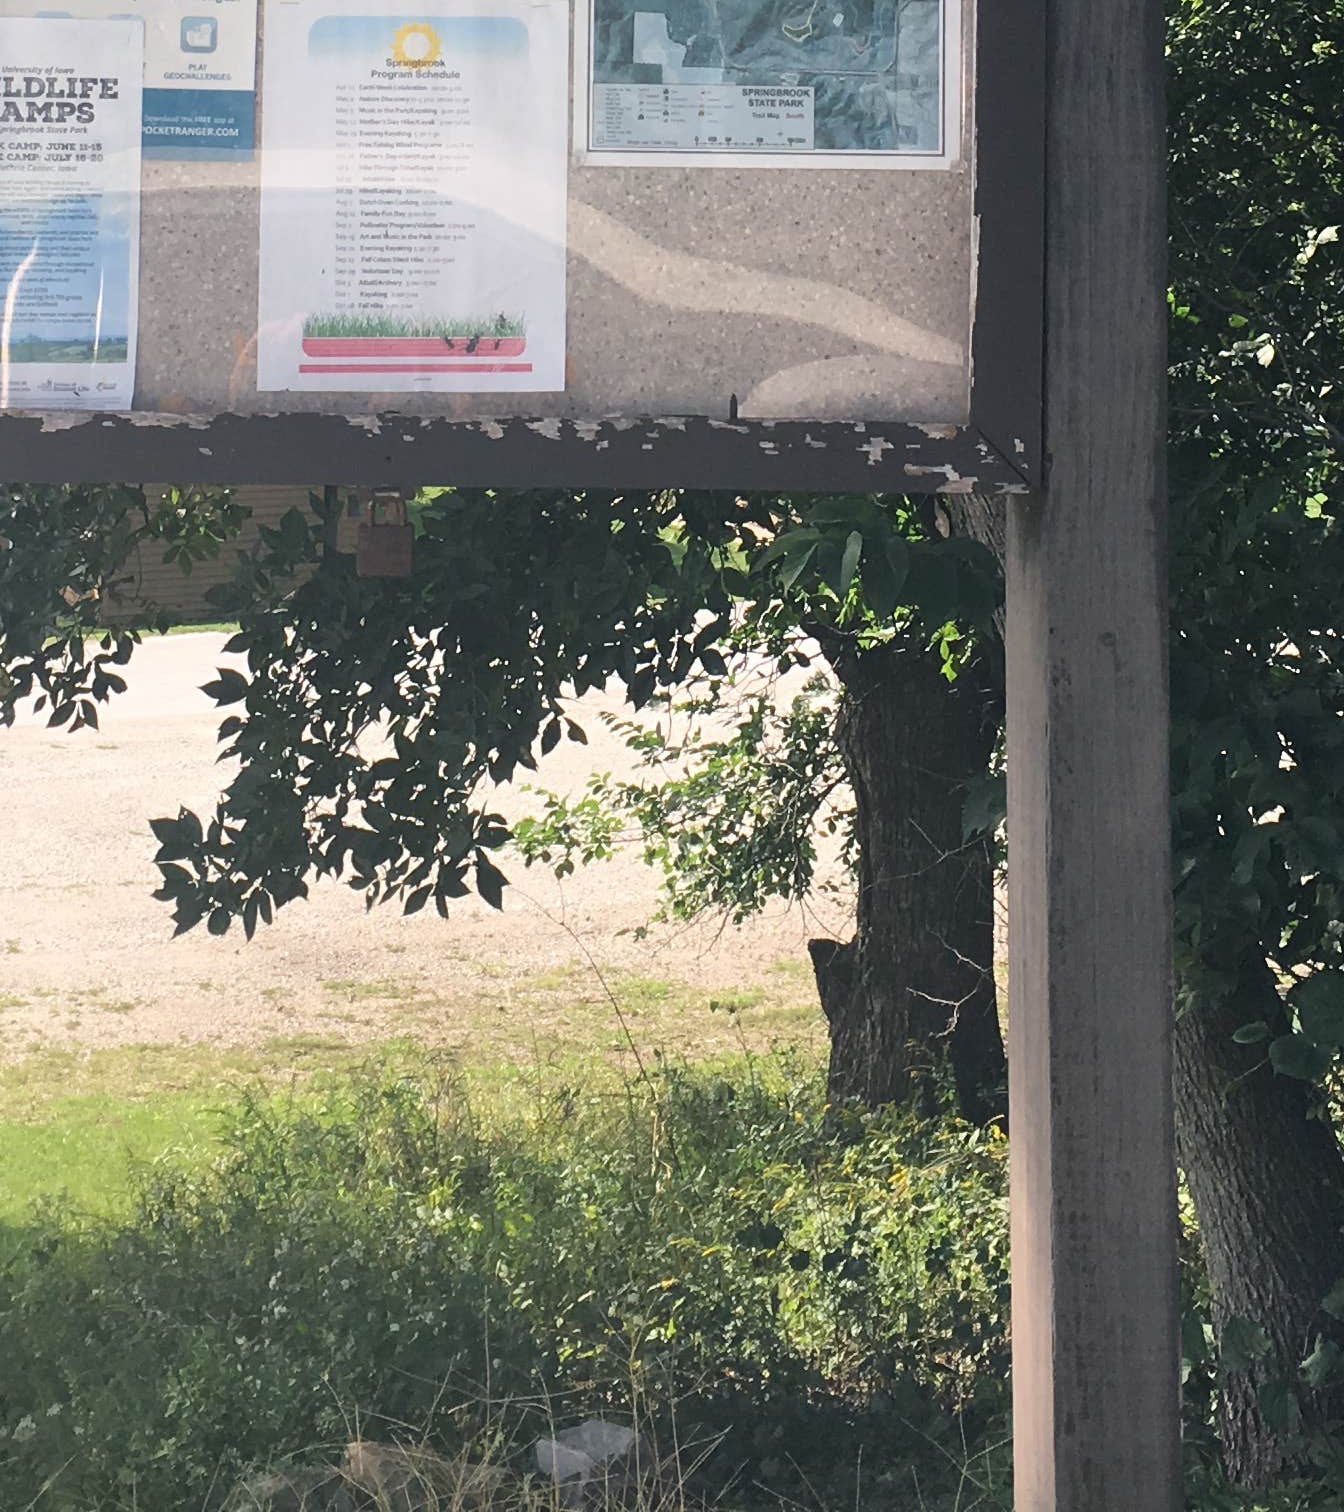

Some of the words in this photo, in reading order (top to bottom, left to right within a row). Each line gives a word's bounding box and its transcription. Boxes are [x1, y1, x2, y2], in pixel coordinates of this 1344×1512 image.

[386, 58, 445, 68] Springbrook
[1, 66, 42, 75] University
[44, 66, 54, 75] of
[188, 64, 207, 72] PLAY
[371, 70, 413, 79] Program
[416, 70, 460, 79] Schedule
[742, 88, 810, 98] SPRINGBROOK
[748, 99, 775, 107] STATE
[778, 99, 804, 107] PARK
[47, 126, 67, 134] State
[70, 126, 87, 134] Park
[8, 142, 42, 151] CAMP:
[46, 143, 76, 151] JUNE
[79, 143, 103, 151] 11-15
[7, 152, 41, 161] CAMP:
[44, 154, 71, 162] JULY
